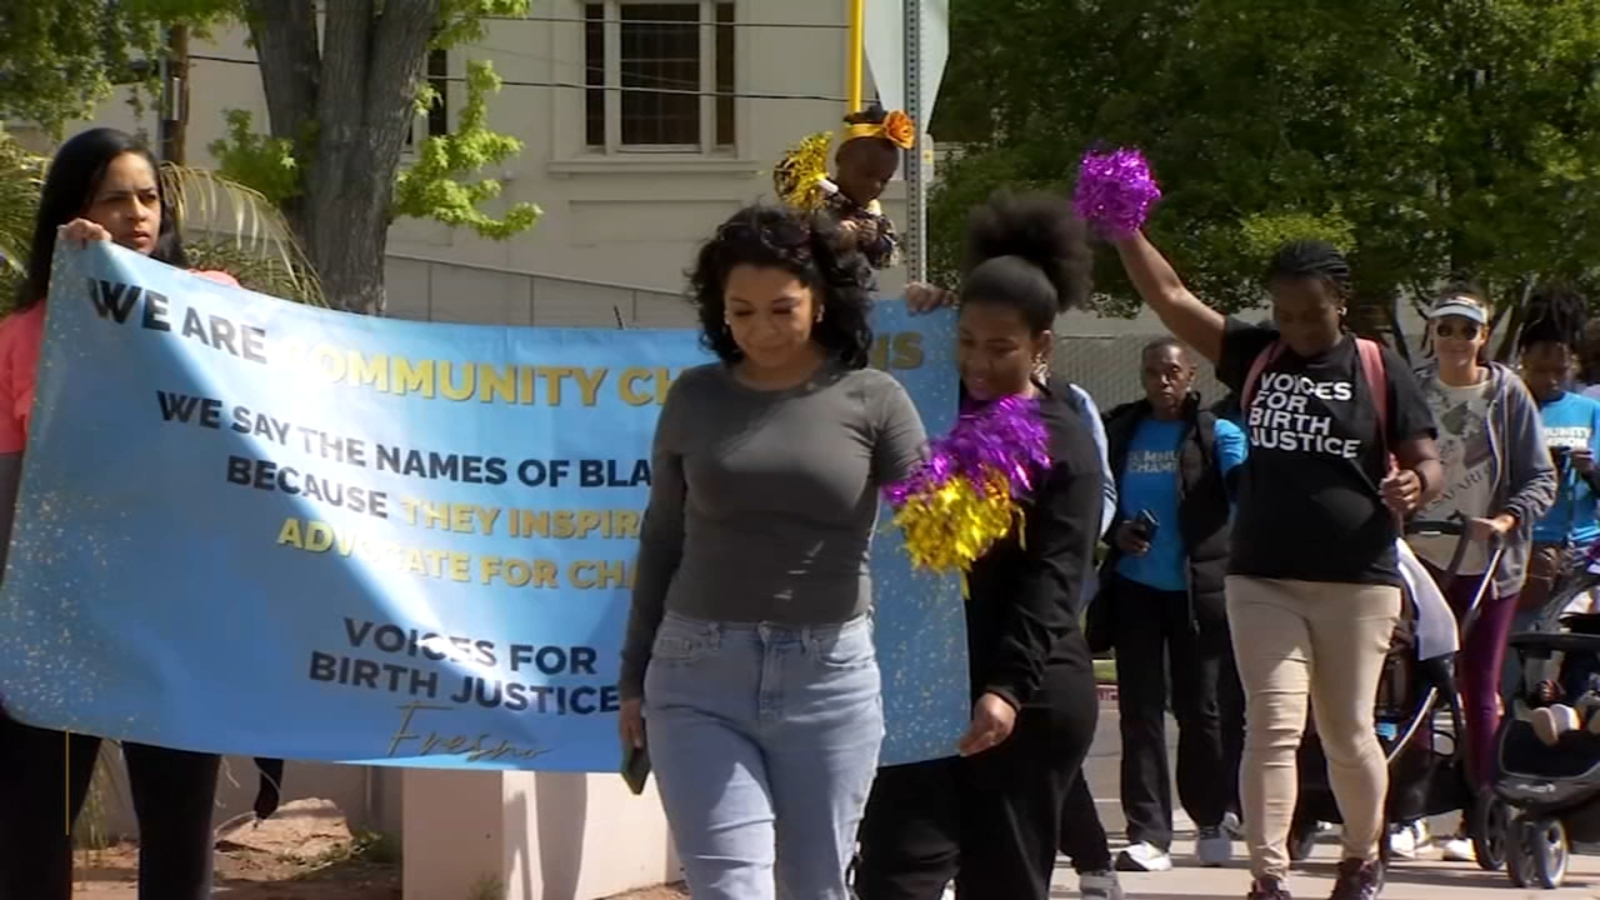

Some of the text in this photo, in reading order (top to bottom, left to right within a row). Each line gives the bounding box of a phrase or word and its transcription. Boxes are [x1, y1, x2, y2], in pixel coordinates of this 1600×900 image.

[89, 278, 171, 331] WE
[182, 306, 267, 364] ARE
[1251, 390, 1308, 413] FOR
[1261, 372, 1352, 400] VOICES
[157, 390, 652, 487] WE SAY THE NAMES OF BLA
[1249, 407, 1331, 436] BIRTH
[1250, 427, 1361, 458] JUSTICE
[227, 455, 640, 540] BECAUSE THEY INSPIR
[480, 556, 558, 589] FOR
[344, 617, 597, 675] VOICES FOR
[309, 651, 621, 715] BIRTH JUSTICE
[387, 701, 551, 762] Fresno
